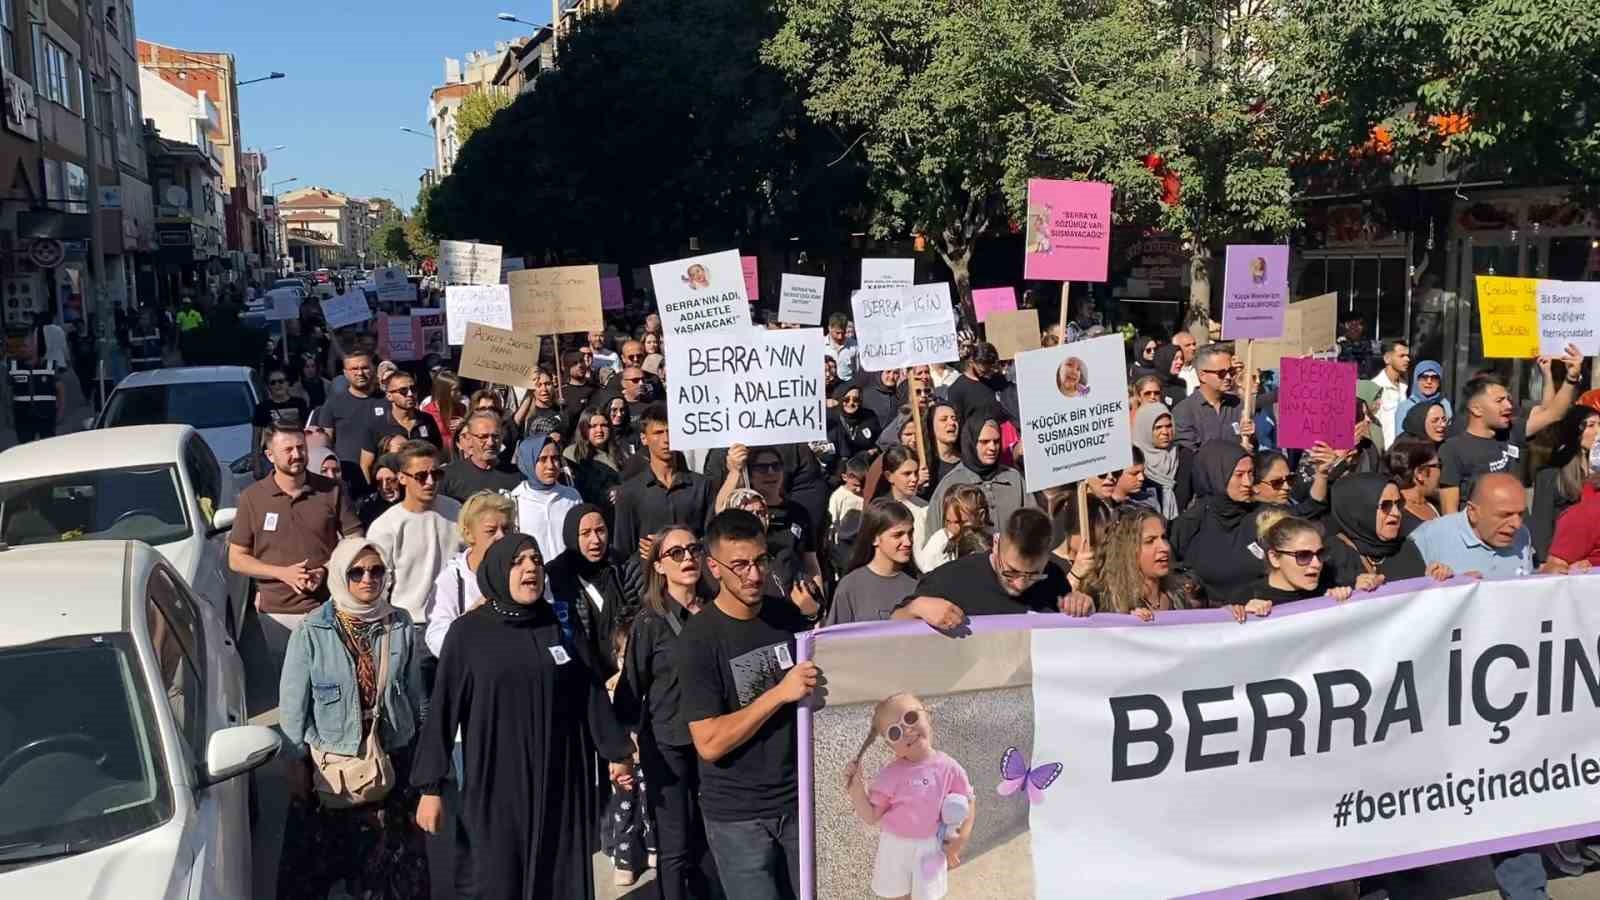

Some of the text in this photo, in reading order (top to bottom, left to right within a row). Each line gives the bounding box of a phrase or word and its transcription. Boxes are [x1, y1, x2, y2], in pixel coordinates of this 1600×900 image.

[680, 304, 732, 323] ADALETLE
[688, 344, 806, 376] BERRA'NIN
[679, 376, 818, 405] ADI, ADALETİN
[682, 400, 824, 436] SESİ OLACAK!
[1070, 407, 1087, 421] BİR
[1089, 401, 1122, 416] YÜREK
[1038, 417, 1114, 444] SUSMASIN DİYE
[1109, 620, 1600, 783] BERRA İÇİN
[1333, 753, 1600, 829] #berraiçinadale
